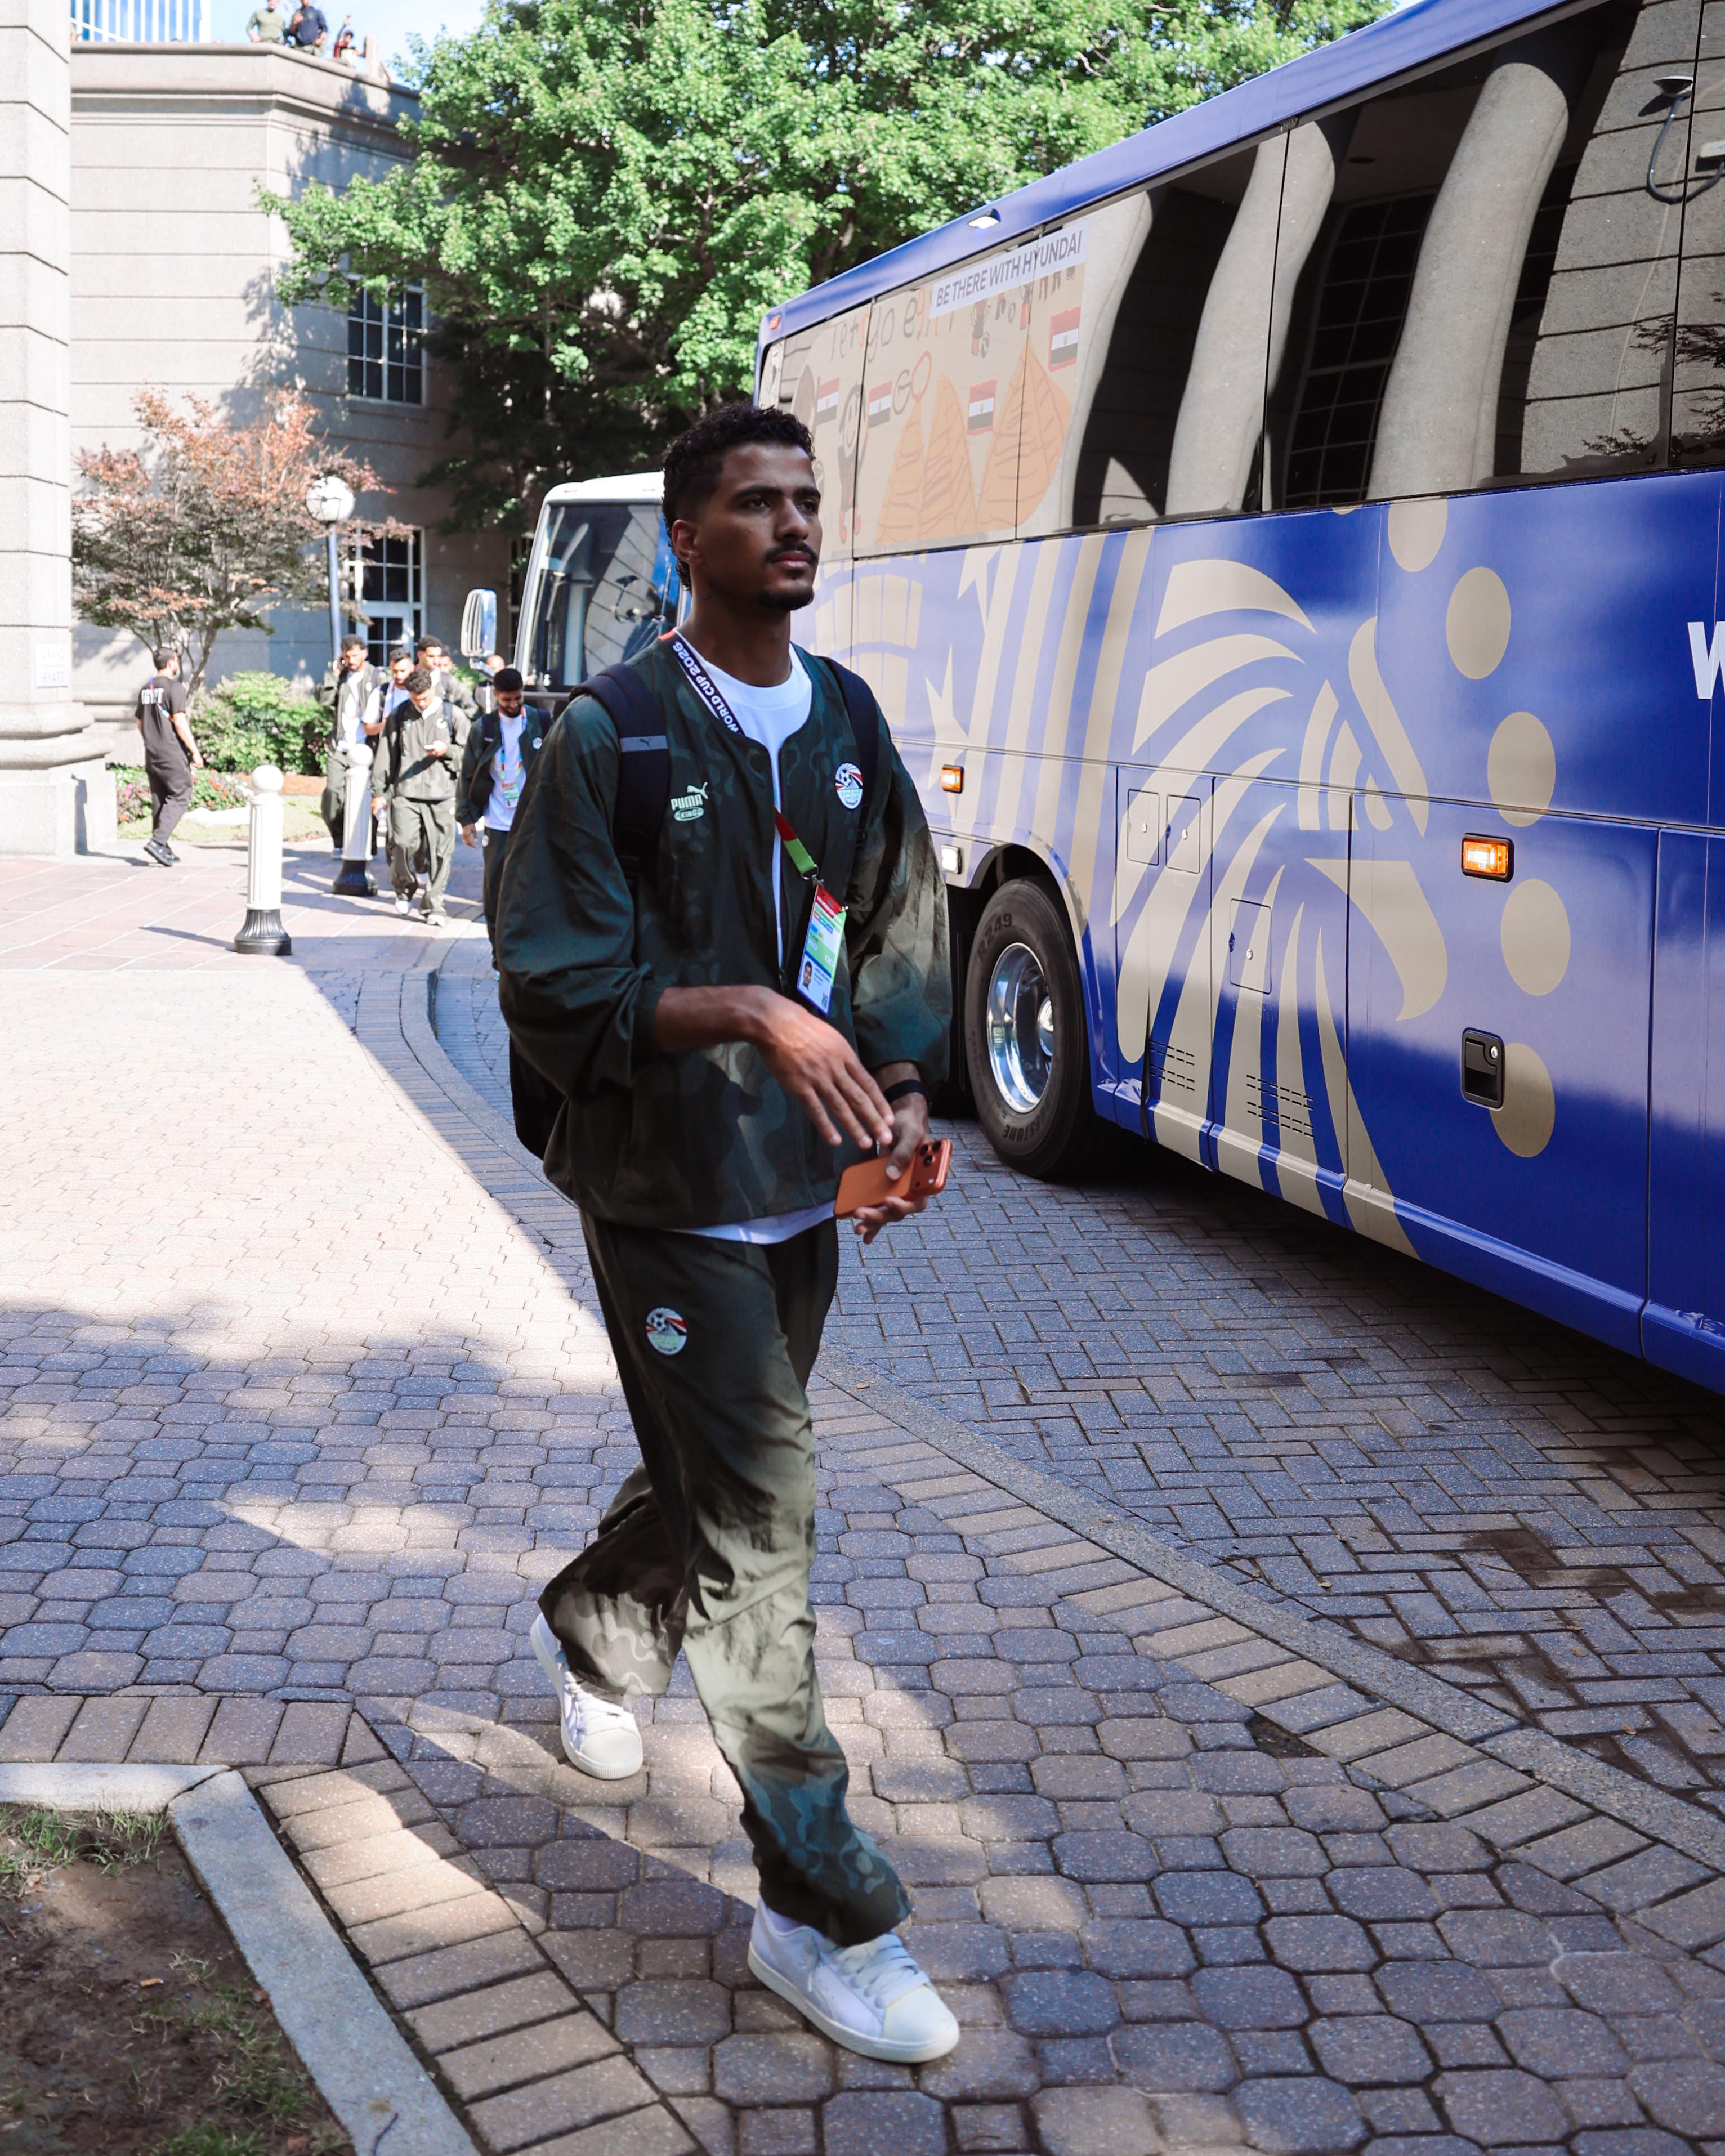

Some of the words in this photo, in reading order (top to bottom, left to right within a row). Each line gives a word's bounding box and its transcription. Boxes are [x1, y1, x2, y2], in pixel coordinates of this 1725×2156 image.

[936, 284, 951, 307] BE
[951, 269, 987, 301] THERE
[989, 255, 1021, 287] WITH
[1022, 230, 1082, 275] HYUNDAI
[672, 641, 701, 677] 2026
[696, 675, 716, 696] CUP
[710, 695, 739, 733] WORLD
[670, 793, 703, 811] PUMA
[680, 809, 698, 818] KING
